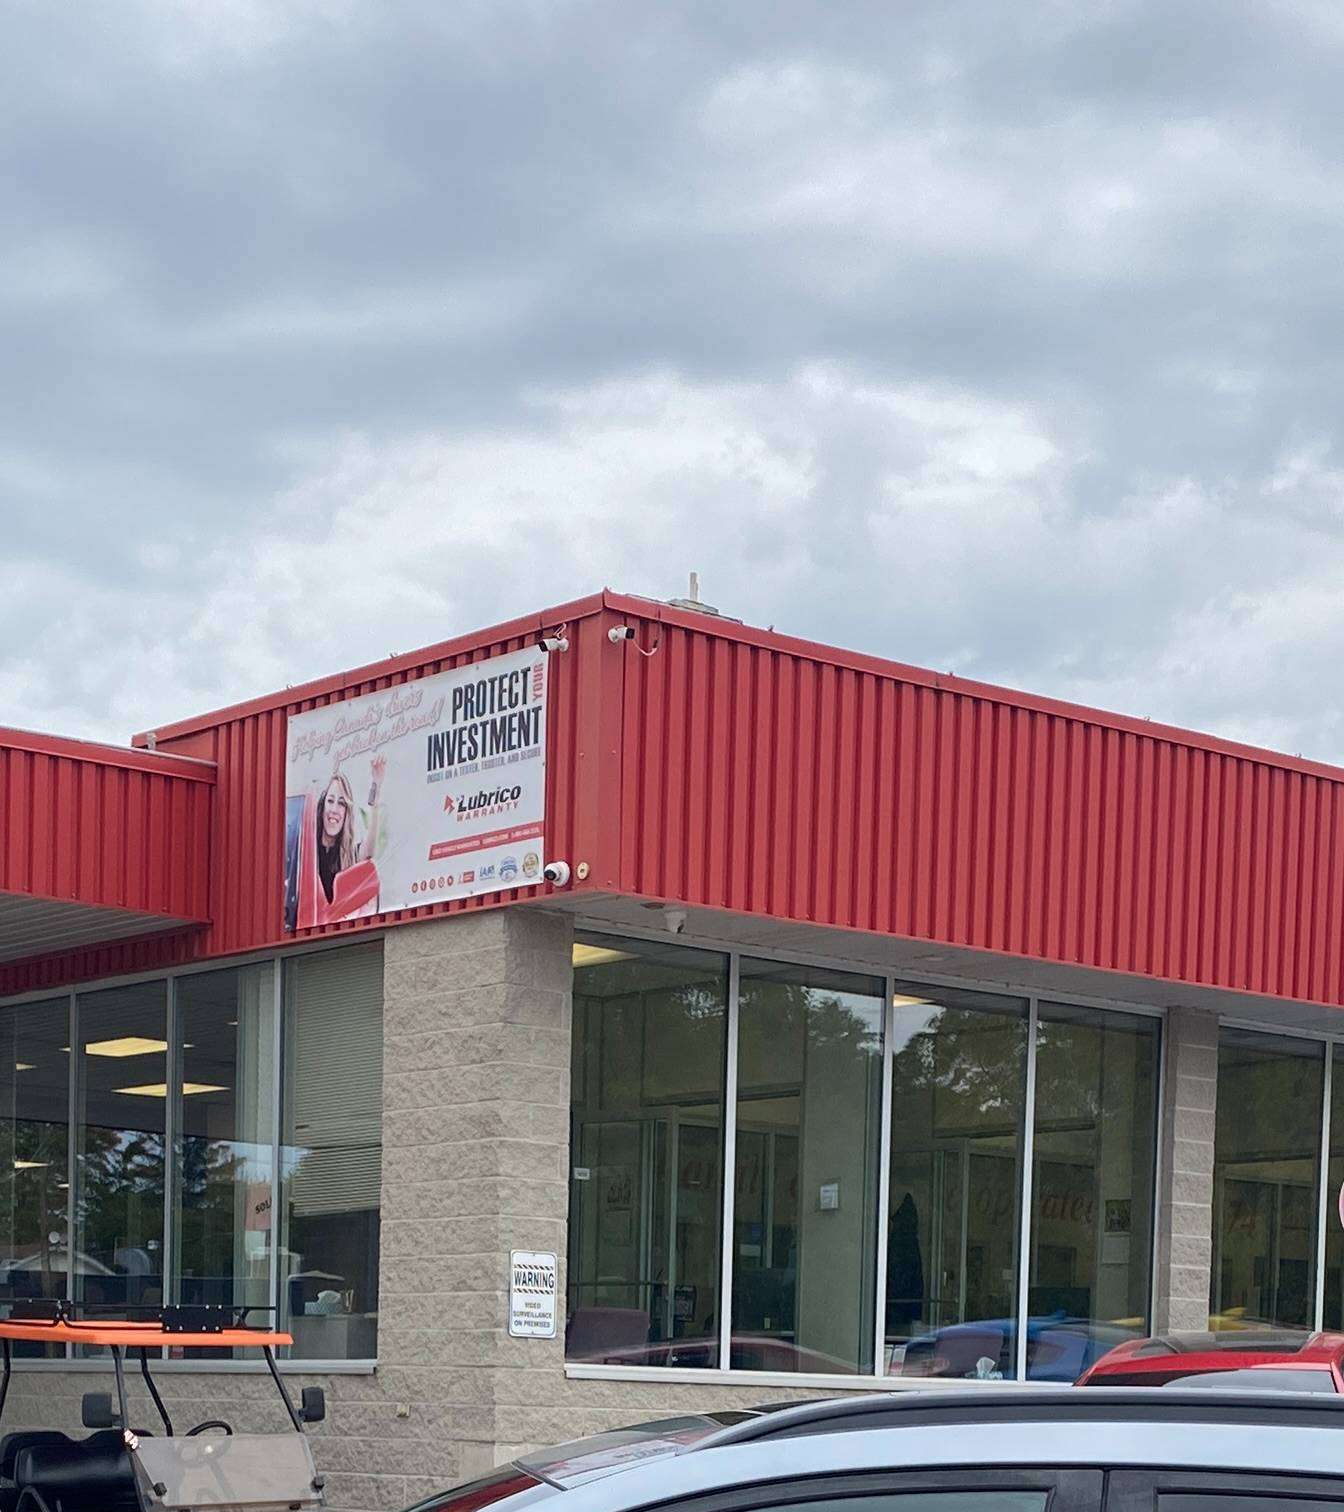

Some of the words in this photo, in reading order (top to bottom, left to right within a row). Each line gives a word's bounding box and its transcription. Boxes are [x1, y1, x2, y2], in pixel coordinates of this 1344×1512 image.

[452, 666, 531, 725] PROTECT
[533, 663, 544, 702] YOUR
[427, 706, 542, 772] INVESTMENT
[457, 785, 522, 812] Lubrico
[456, 801, 519, 821] WARRANTY
[514, 1271, 554, 1289] WARNING
[514, 1319, 523, 1327] ON
